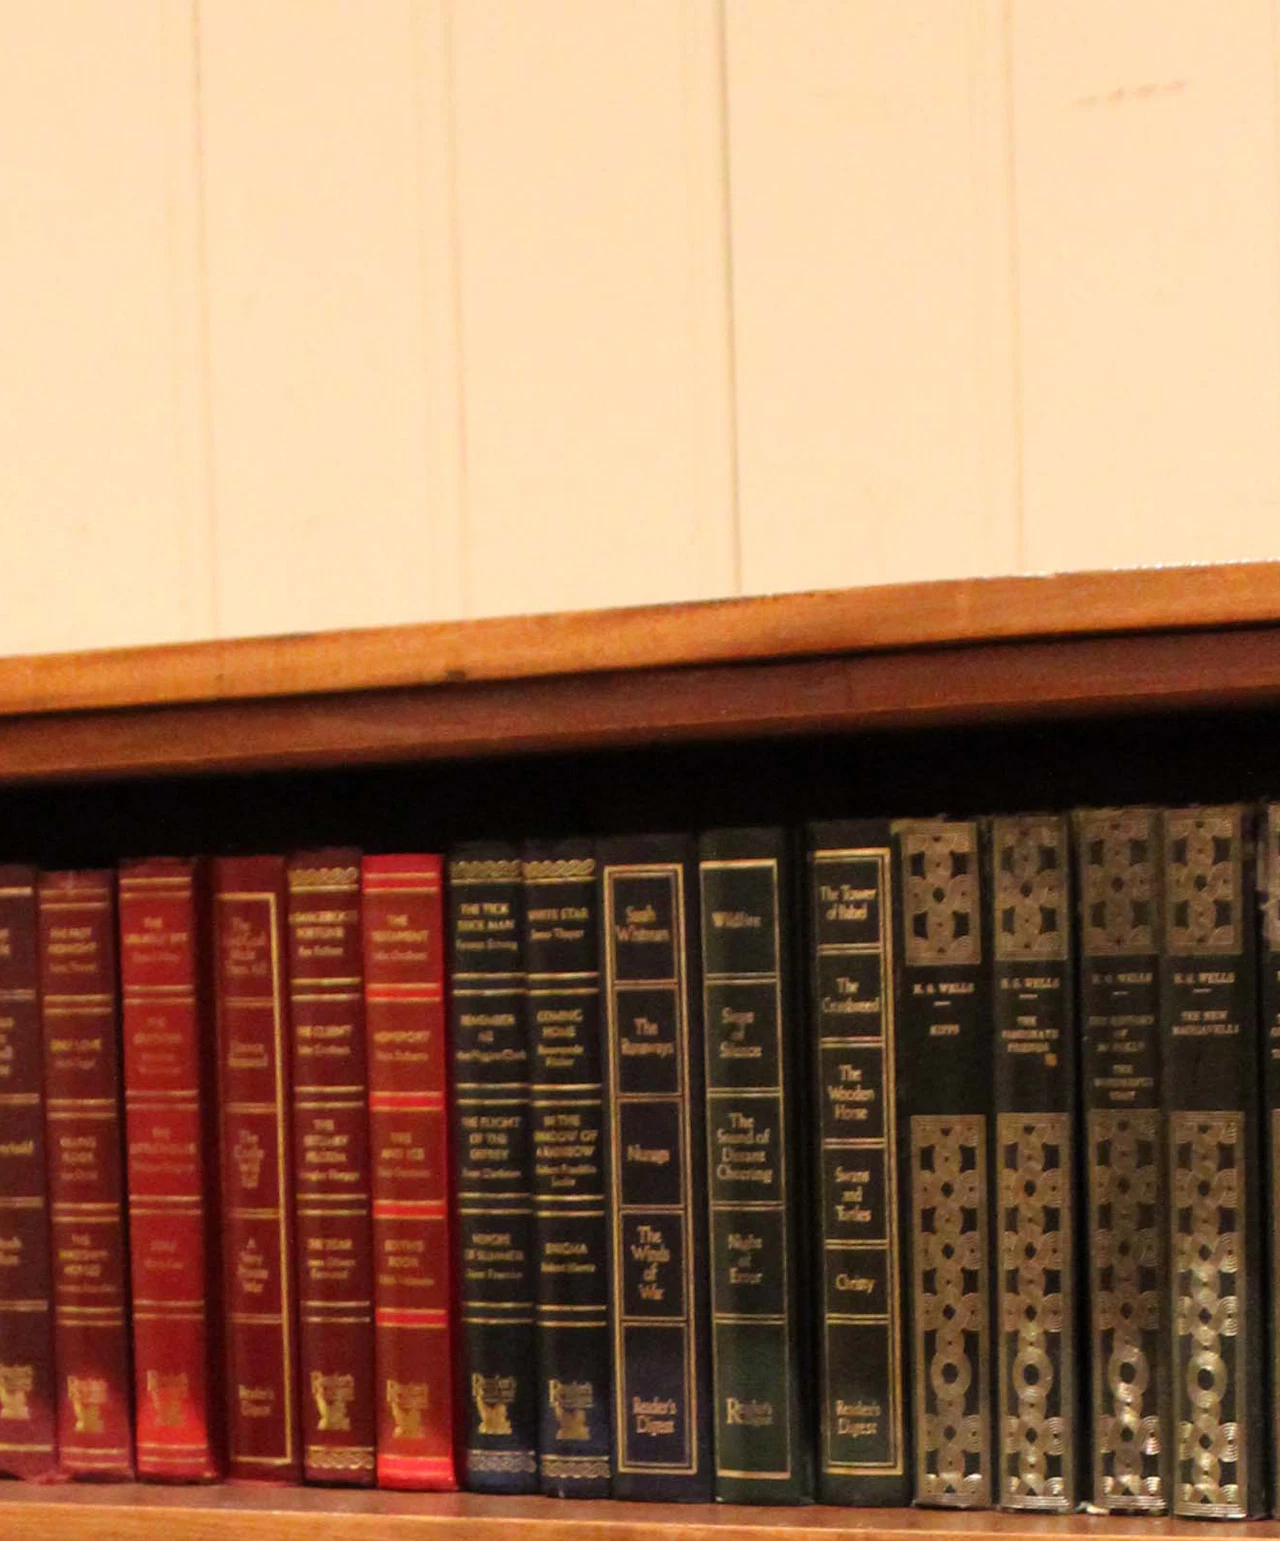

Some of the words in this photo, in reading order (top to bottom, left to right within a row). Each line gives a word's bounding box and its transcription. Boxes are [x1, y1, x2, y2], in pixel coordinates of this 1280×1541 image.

[836, 976, 860, 993] The
[633, 1018, 658, 1035] The
[838, 1063, 862, 1082] The
[728, 1112, 754, 1129] The
[756, 1128, 771, 1145] of
[637, 1225, 663, 1244] The
[644, 1264, 657, 1281] of
[640, 1283, 664, 1300] War
